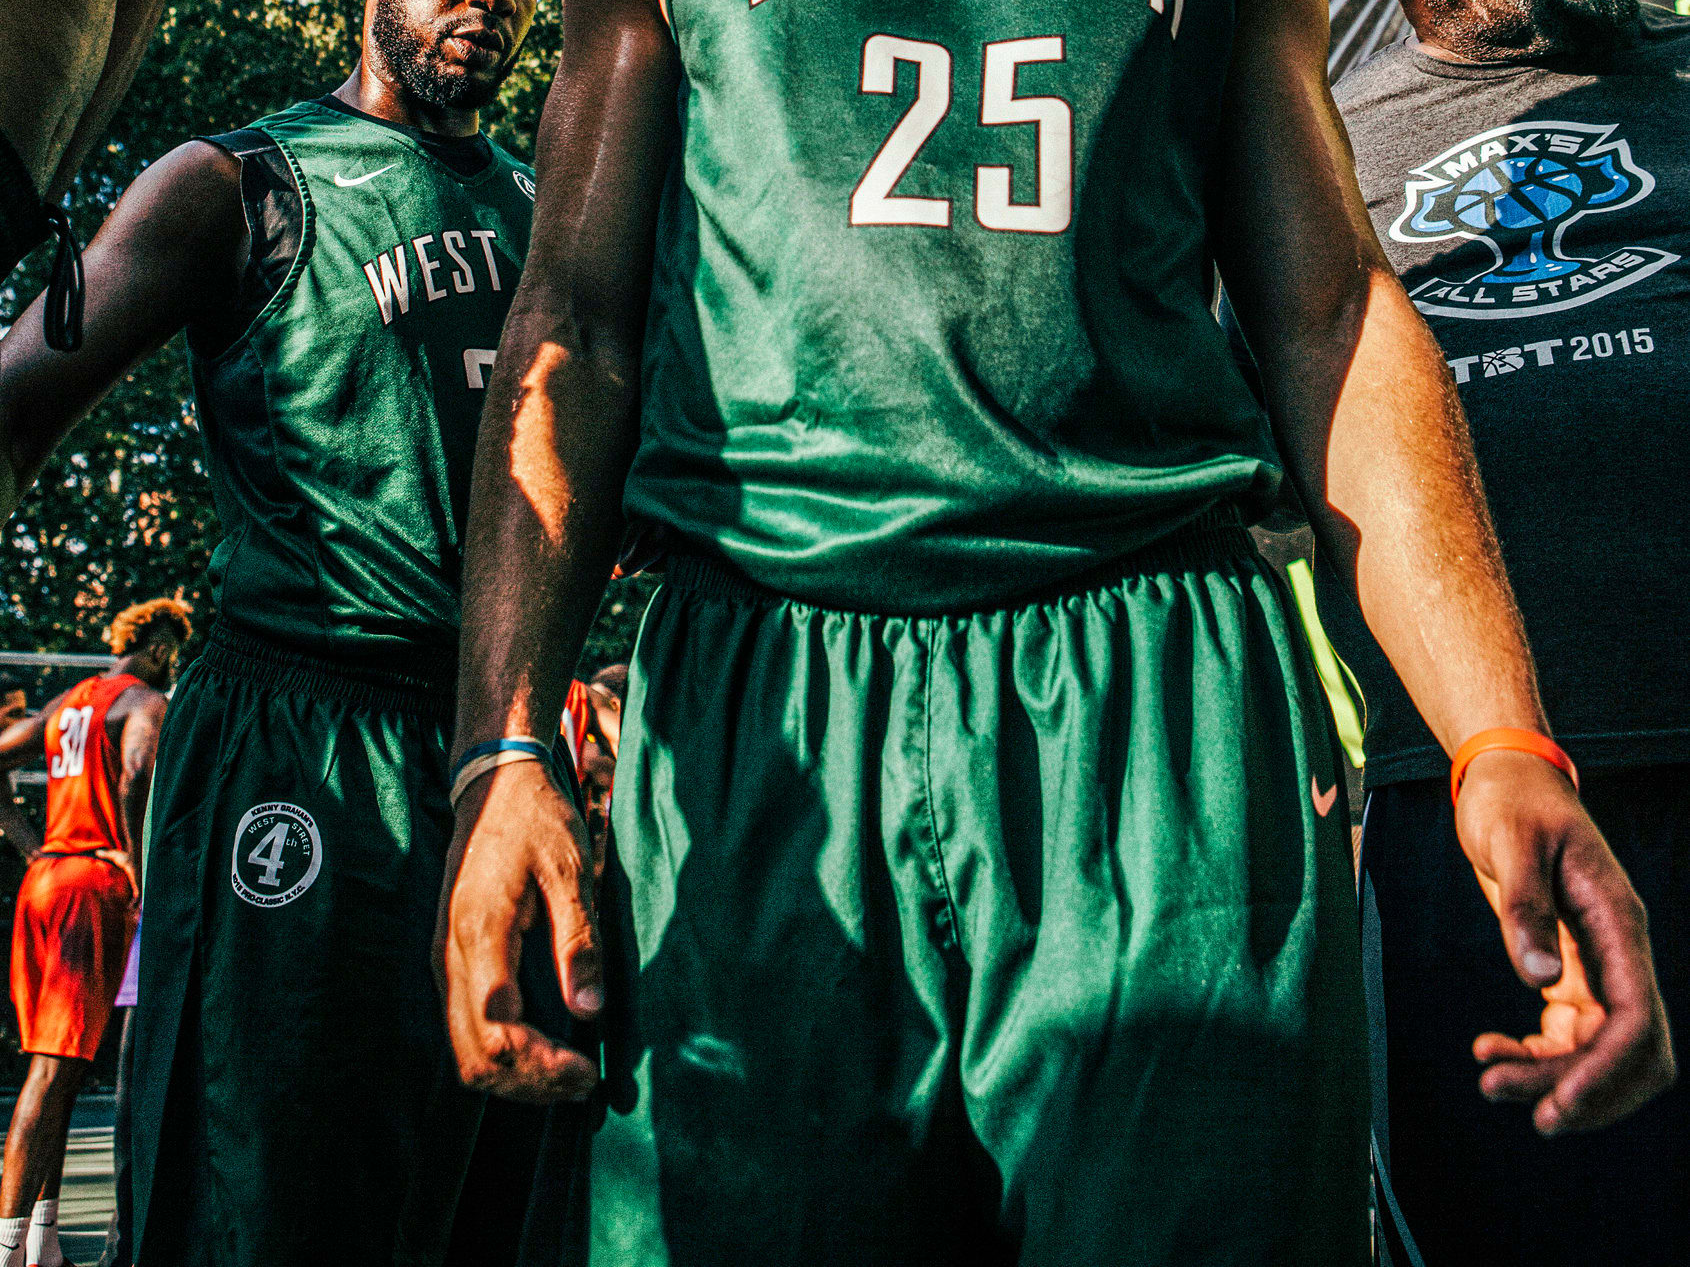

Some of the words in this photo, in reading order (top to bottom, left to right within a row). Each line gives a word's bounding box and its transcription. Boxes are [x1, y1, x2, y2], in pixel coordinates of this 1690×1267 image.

[848, 33, 1074, 234] 25
[1441, 132, 1585, 179] MAX'S
[362, 229, 502, 326] WEST
[1426, 284, 1496, 304] ALL
[1511, 251, 1646, 302] STARS
[1447, 338, 1564, 385] TBT
[1570, 327, 1655, 362] 2015
[248, 816, 275, 834] WEST
[291, 822, 311, 857] STREET
[251, 804, 279, 817] KENNY
